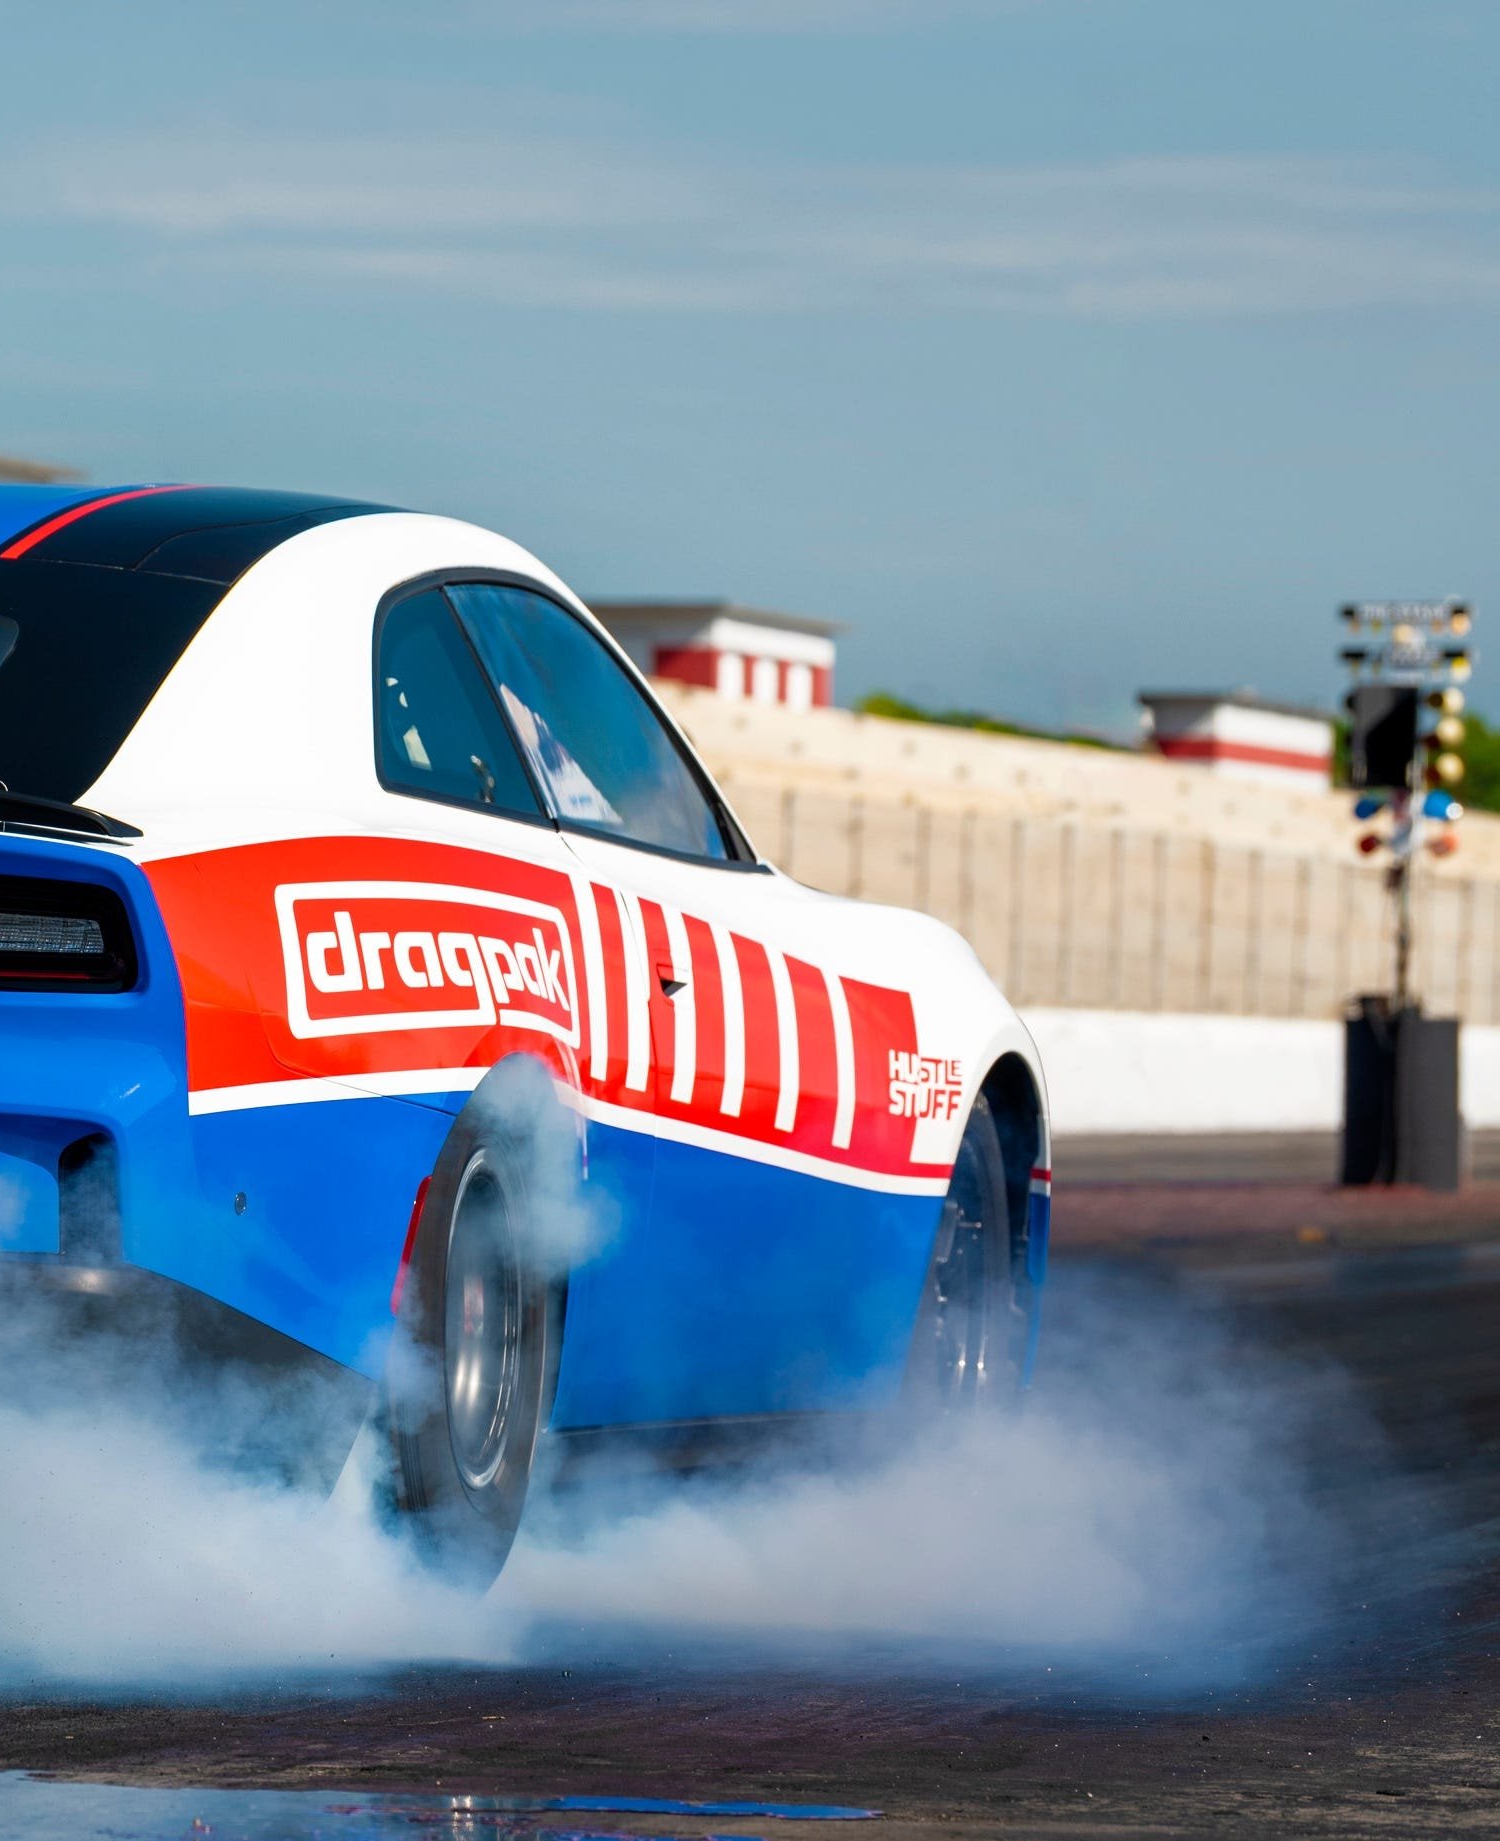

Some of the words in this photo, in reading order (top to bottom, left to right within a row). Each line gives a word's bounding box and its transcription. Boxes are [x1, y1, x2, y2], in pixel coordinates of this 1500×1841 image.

[306, 911, 571, 1012] dragpak
[888, 1049, 963, 1086] HUSTLE
[888, 1080, 963, 1120] STUFF
